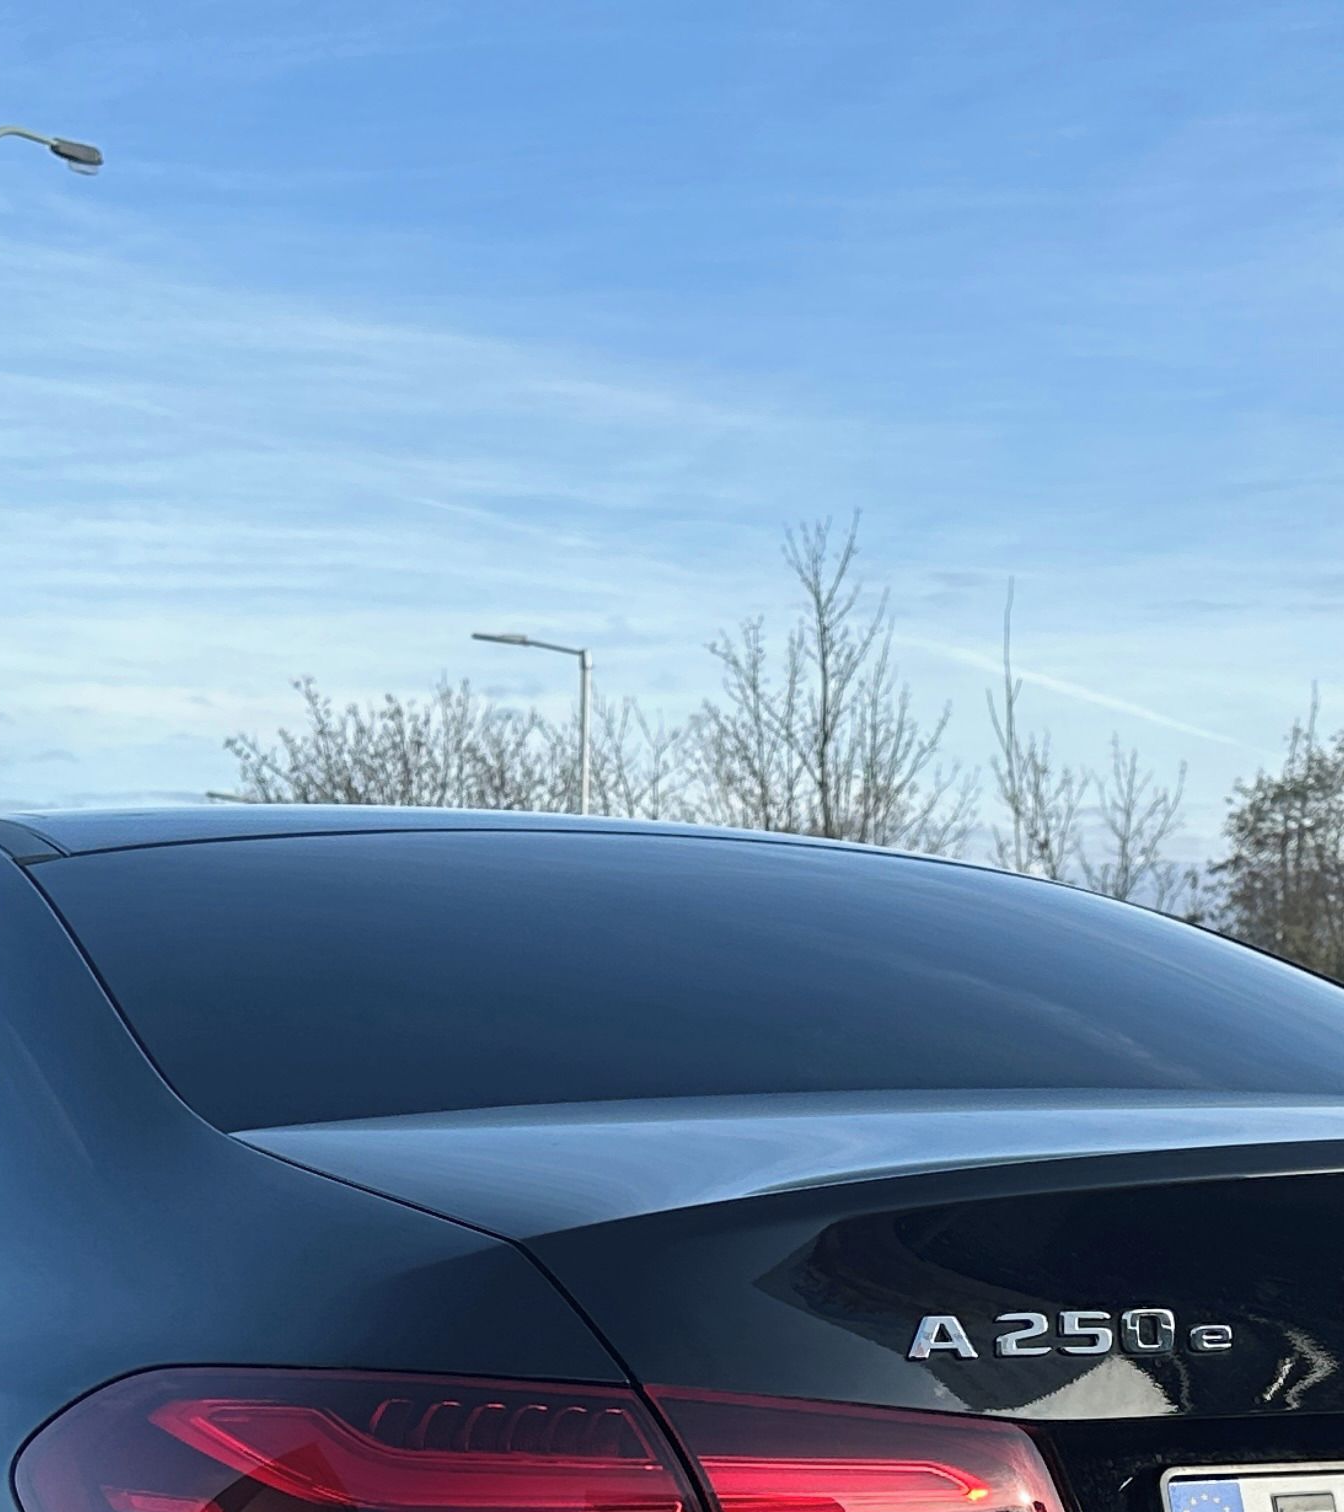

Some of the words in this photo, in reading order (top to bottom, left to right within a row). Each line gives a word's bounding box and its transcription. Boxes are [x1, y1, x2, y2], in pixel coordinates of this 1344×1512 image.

[908, 1315, 978, 1359] A
[995, 1308, 1176, 1357] 250
[1190, 1324, 1233, 1352] e
